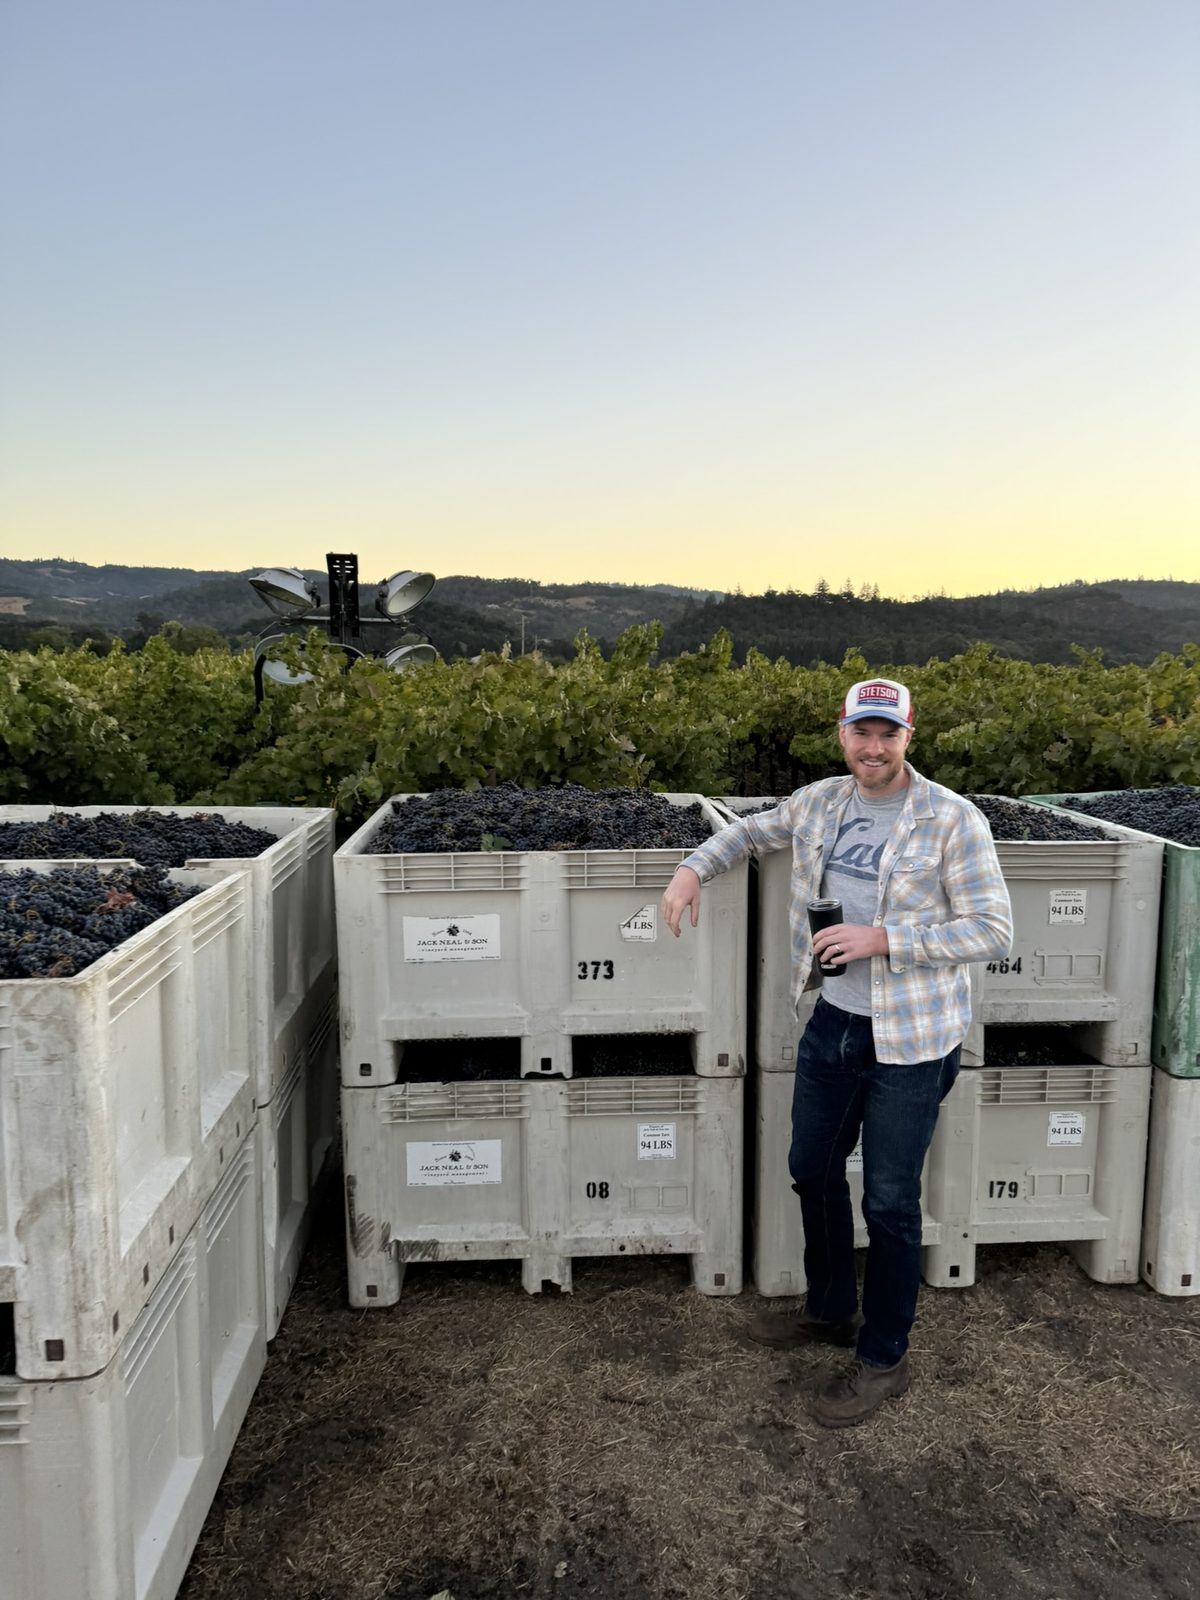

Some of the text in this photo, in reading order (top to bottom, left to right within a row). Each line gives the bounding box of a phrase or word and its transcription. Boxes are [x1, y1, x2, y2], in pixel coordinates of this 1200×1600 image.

[860, 686, 897, 699] STETSON
[1051, 905, 1084, 915] 94 LBS
[633, 921, 653, 929] LBS
[578, 960, 614, 980] 373
[986, 957, 1022, 974] 464
[1051, 1127, 1082, 1135] 94 LBS
[641, 1140, 672, 1150] 94 LBS
[586, 1181, 609, 1199] 08
[989, 1181, 1018, 1198] 179
